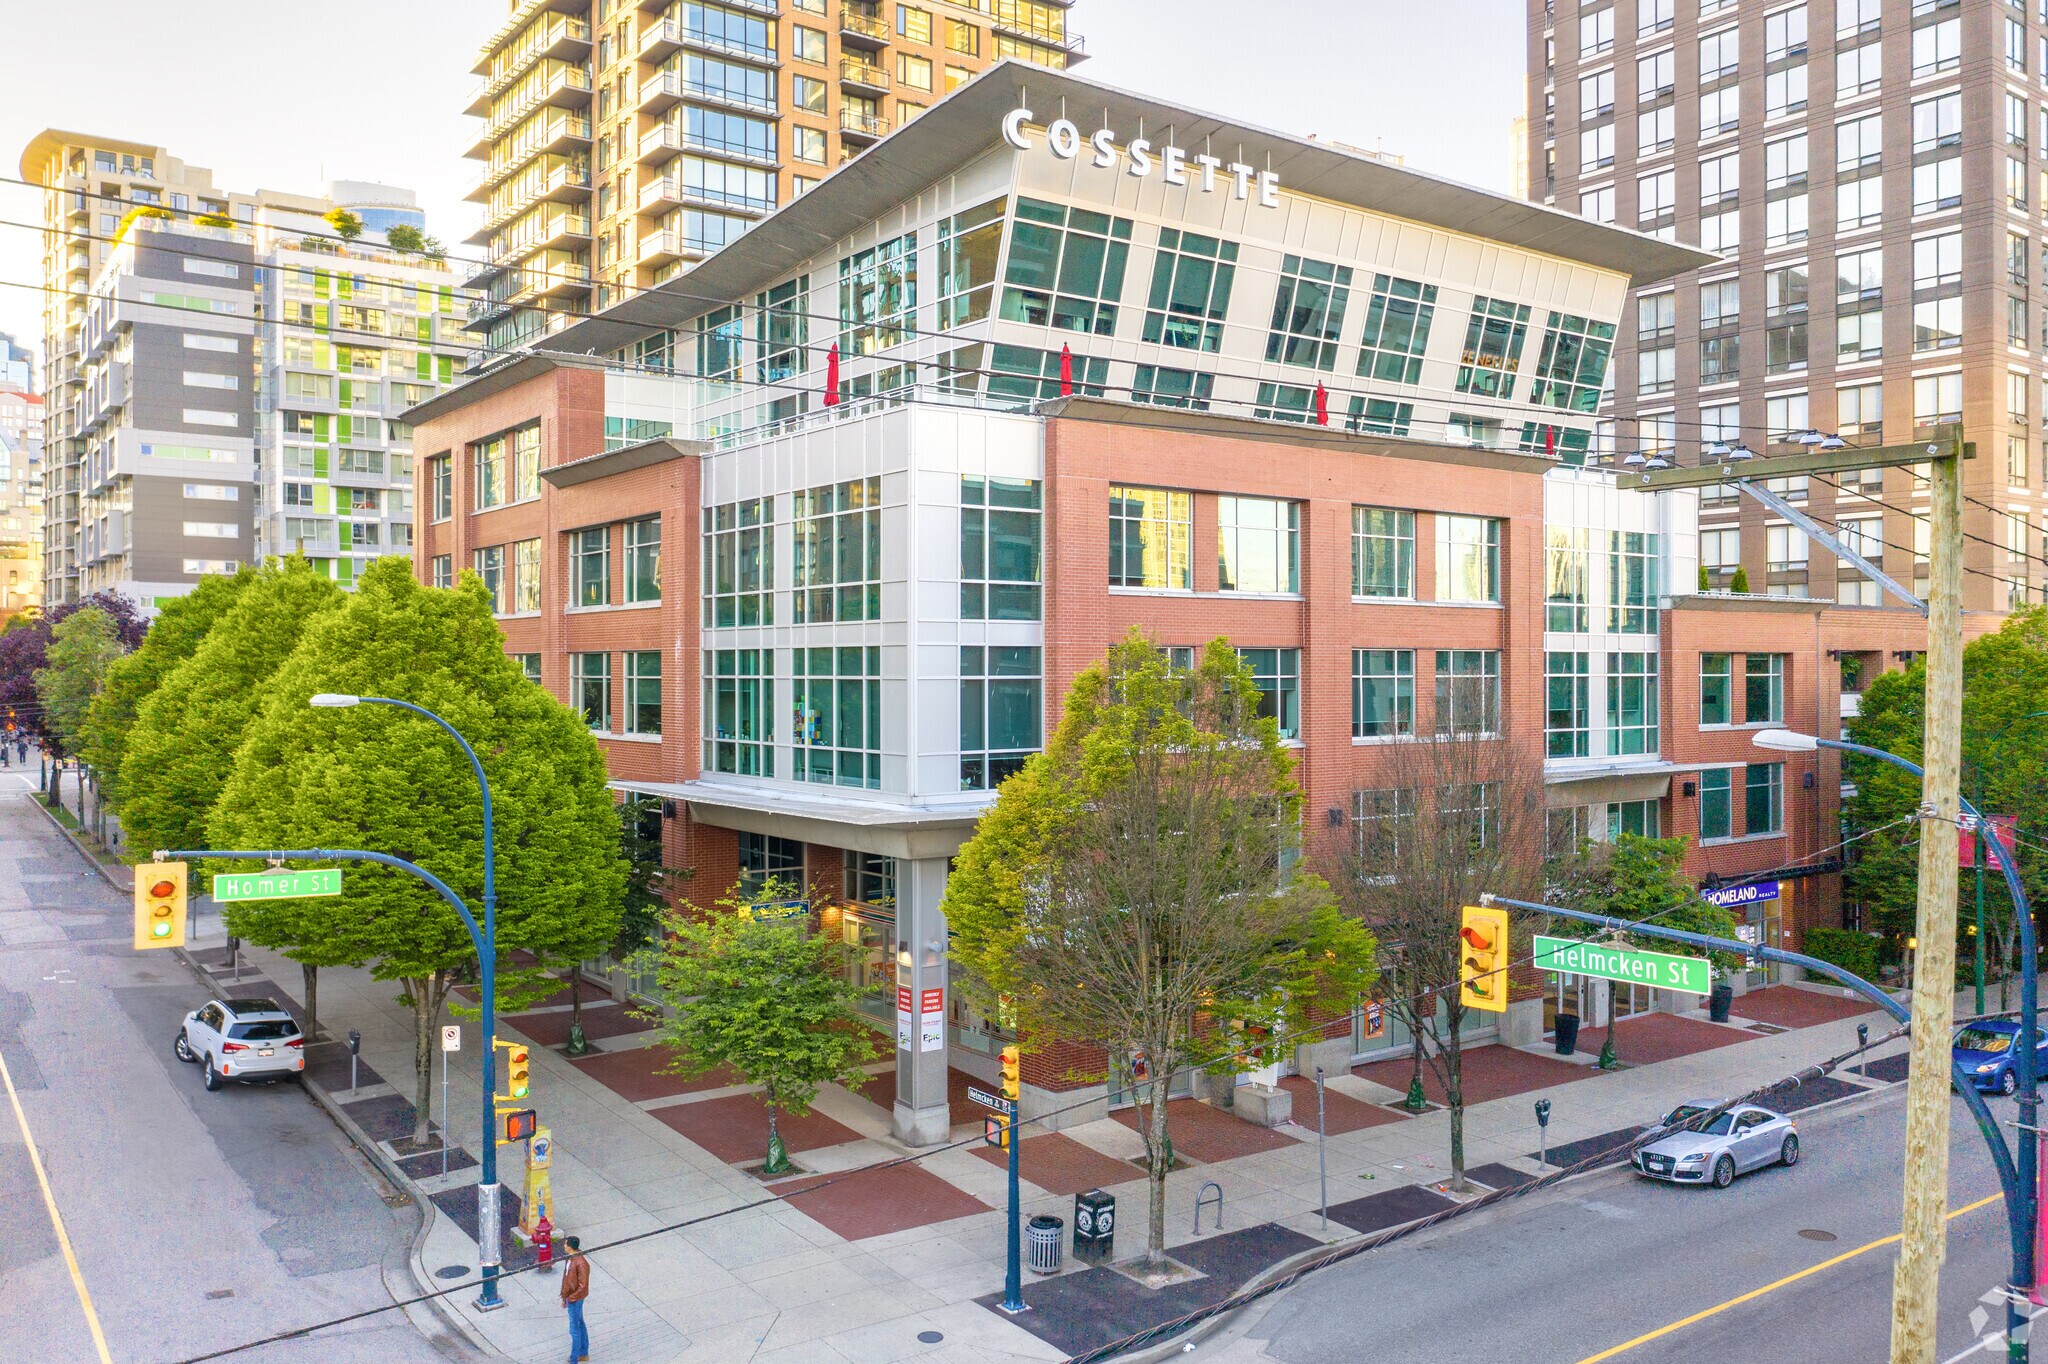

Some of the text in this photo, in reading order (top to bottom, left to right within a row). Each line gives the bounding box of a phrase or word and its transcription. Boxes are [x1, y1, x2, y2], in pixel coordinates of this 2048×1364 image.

[1002, 108, 1279, 209] COSSETTE
[227, 874, 329, 896] Homer St
[1708, 886, 1757, 906] HOMELAND
[1553, 944, 1690, 986] Helmcken St
[923, 1033, 941, 1043] Epic
